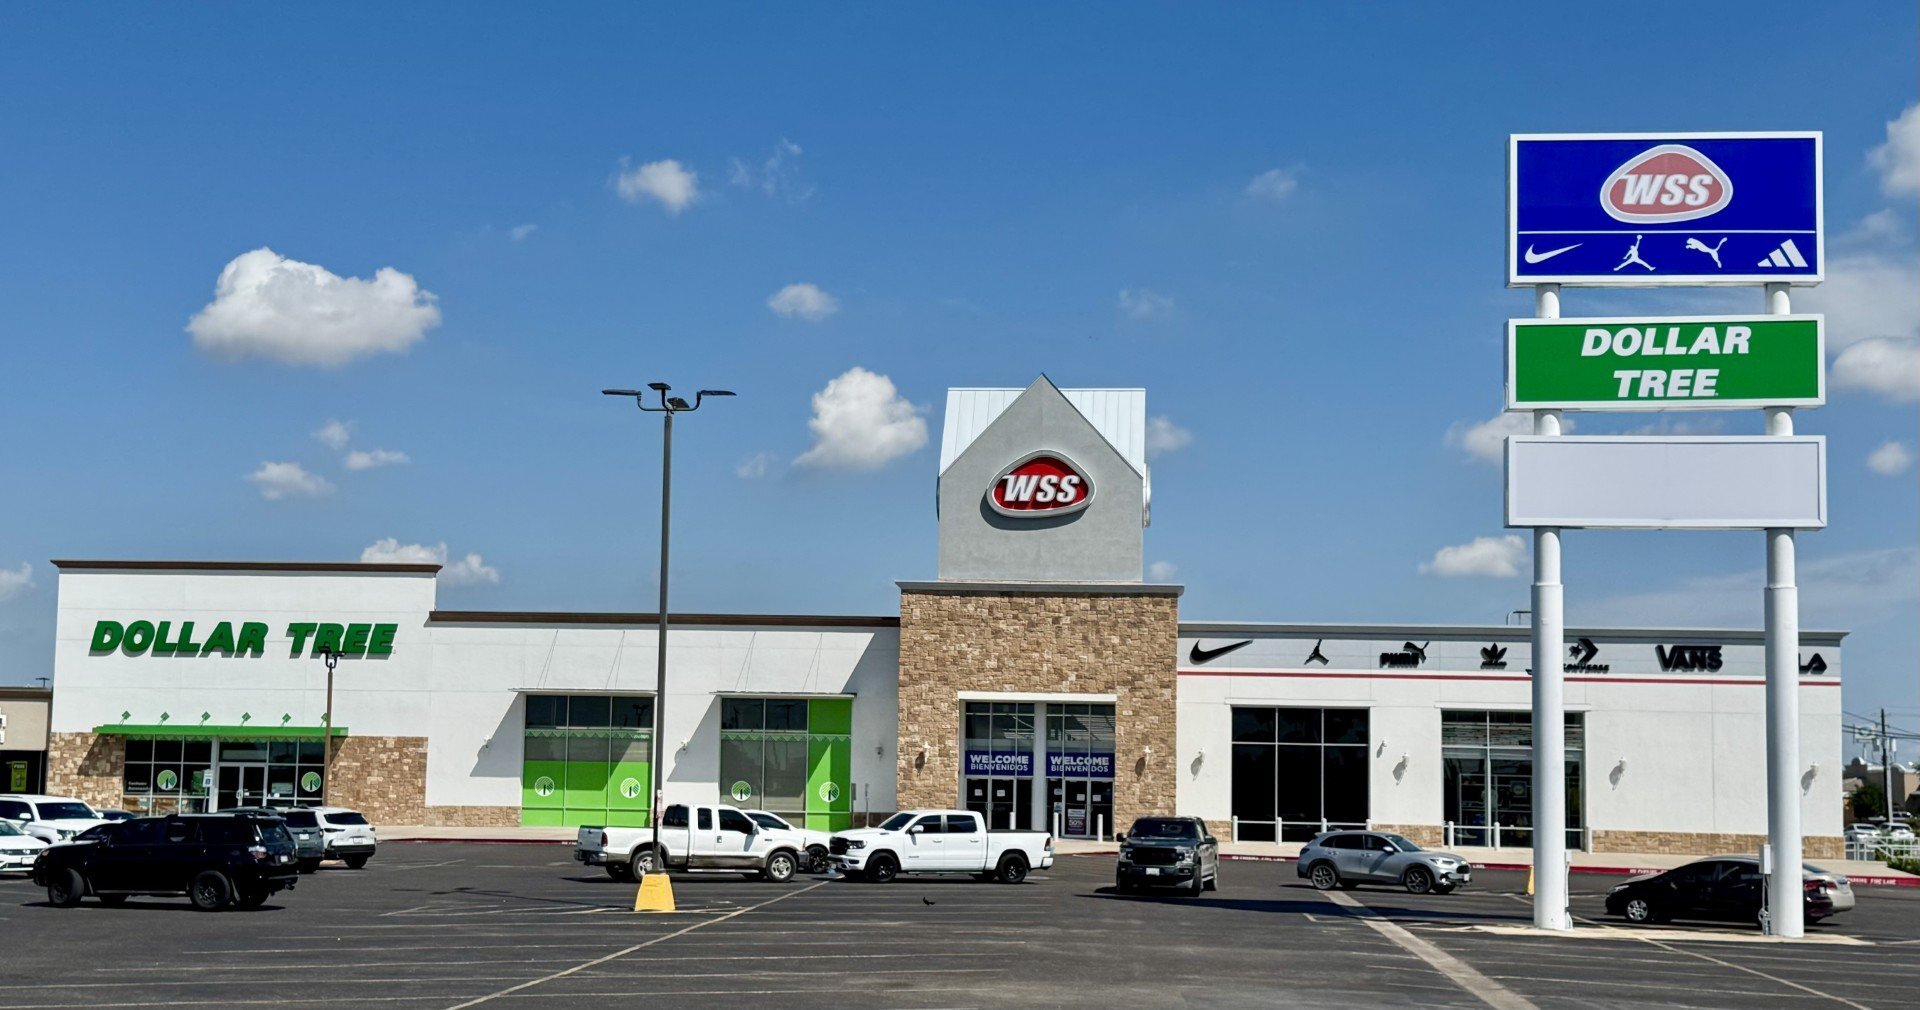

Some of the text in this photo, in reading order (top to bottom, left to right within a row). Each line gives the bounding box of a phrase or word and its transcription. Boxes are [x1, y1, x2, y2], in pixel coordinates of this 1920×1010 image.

[1620, 173, 1713, 206] WSS
[1581, 326, 1752, 357] DOLLAR
[1613, 369, 1720, 398] TREE
[1002, 475, 1080, 502] WSS
[91, 620, 398, 656] DOLLAR TREE
[1655, 644, 1723, 671] VANS
[970, 754, 1029, 764] WELCOME
[970, 763, 1028, 771] BIENVENIDOS
[1050, 756, 1109, 766] WELCOME
